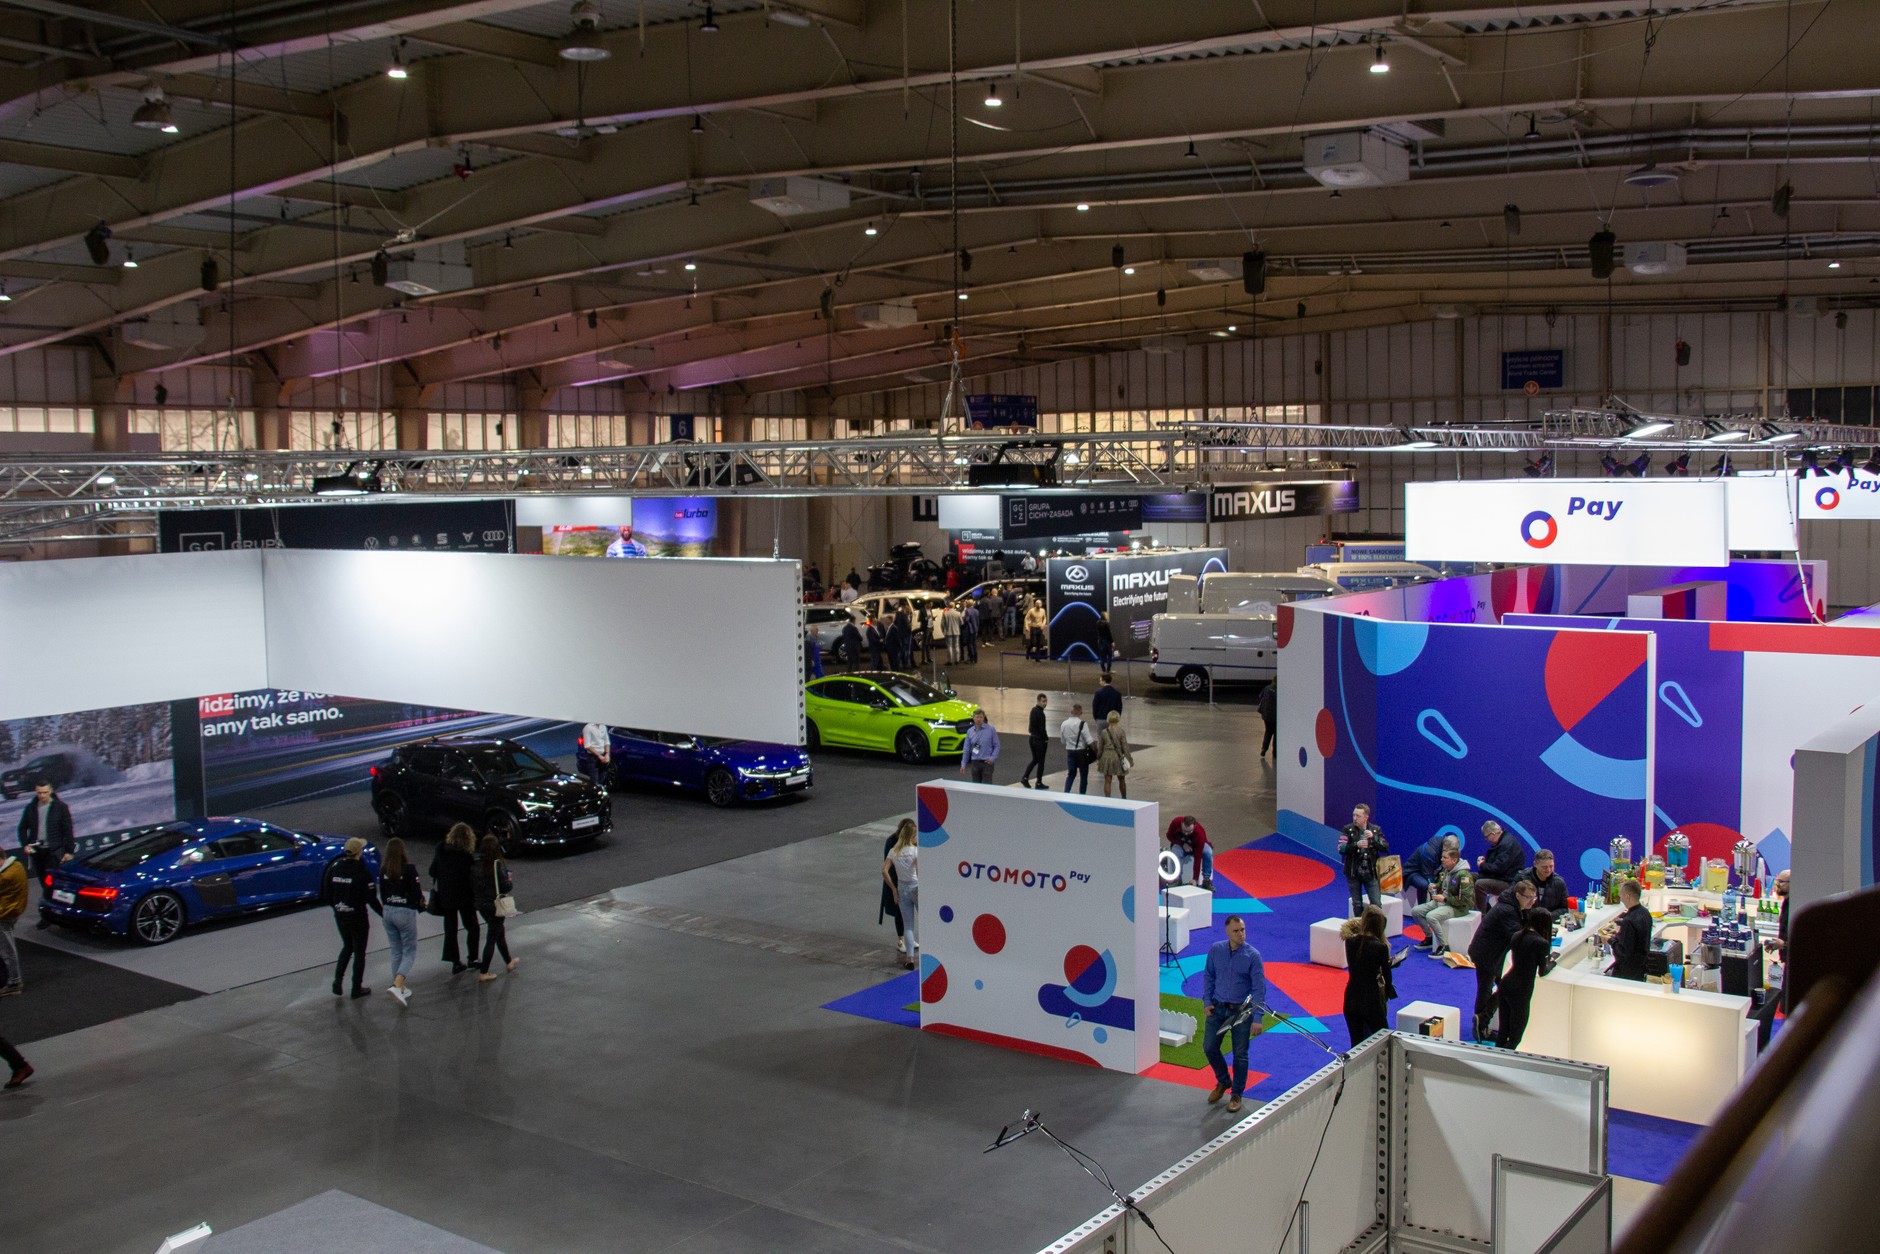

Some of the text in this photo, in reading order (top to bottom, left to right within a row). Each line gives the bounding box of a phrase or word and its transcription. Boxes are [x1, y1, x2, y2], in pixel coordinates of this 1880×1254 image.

[678, 420, 687, 437] 6
[1028, 503, 1050, 511] GRUPA
[1028, 510, 1074, 519] CICHY-ZASADA
[1214, 490, 1296, 516] MAXUS
[1567, 496, 1624, 521] Pay
[1113, 568, 1182, 591] MAXU
[1113, 591, 1168, 607] Electrifying the futur
[201, 707, 344, 737] amy tak samo.
[958, 861, 1091, 892] OTOMOTO Pay
